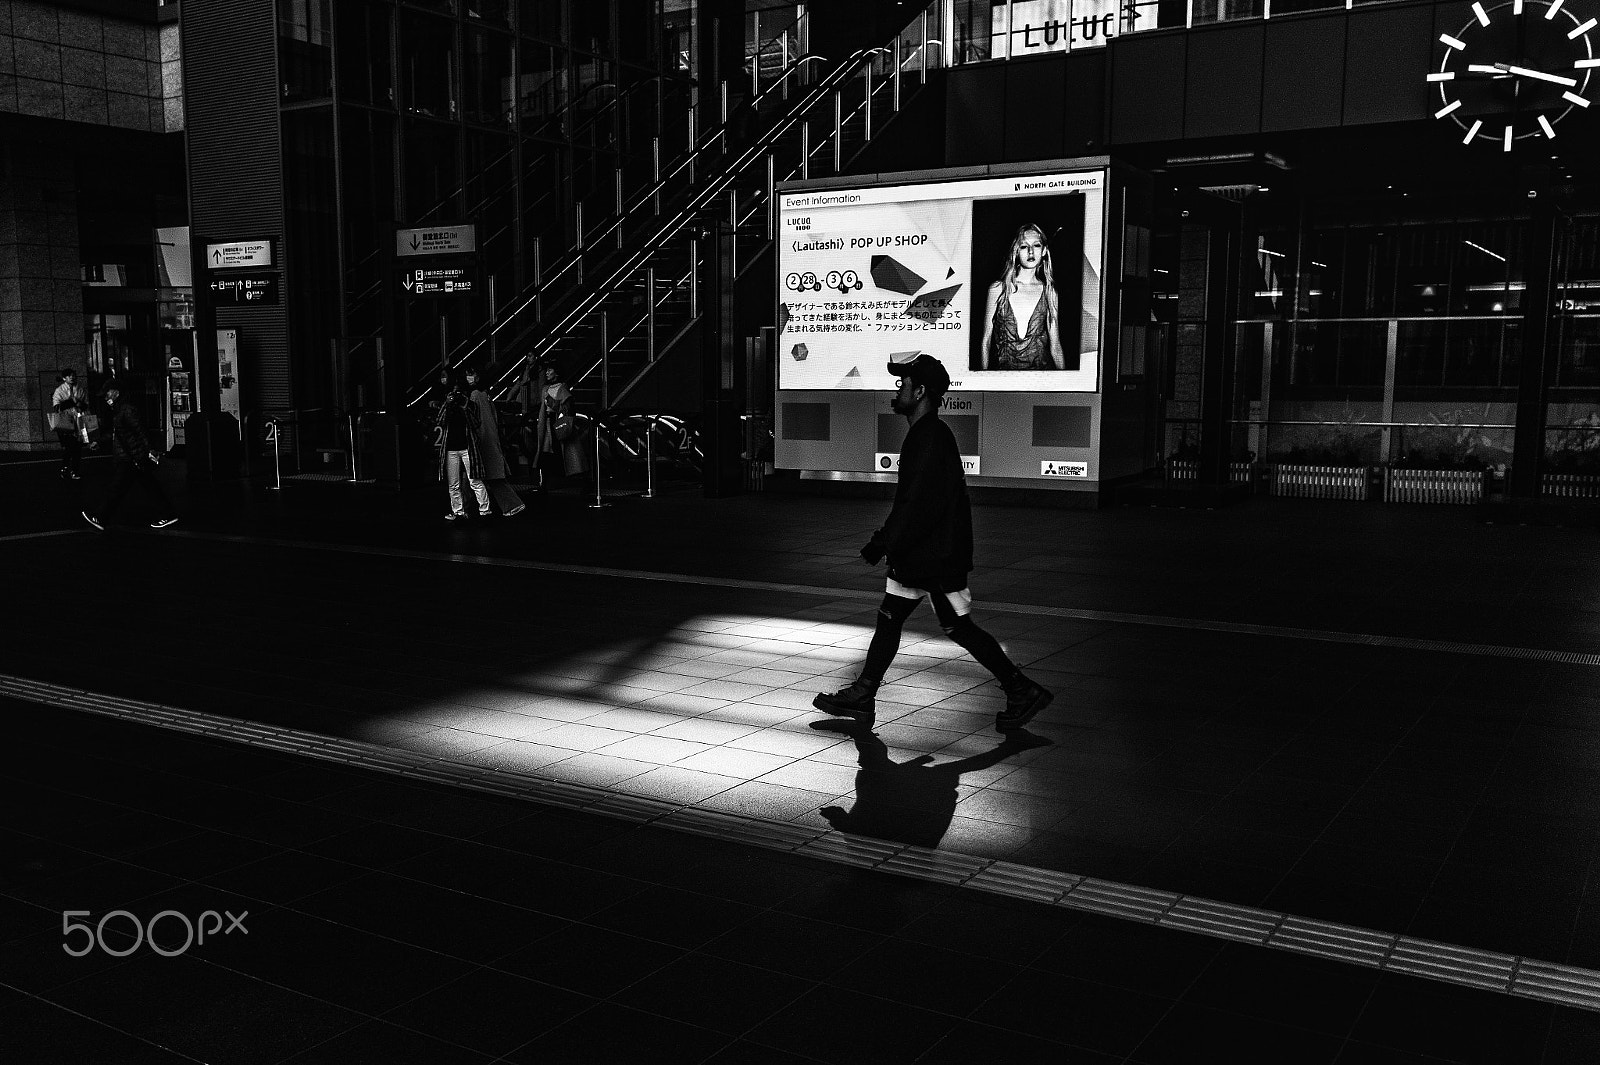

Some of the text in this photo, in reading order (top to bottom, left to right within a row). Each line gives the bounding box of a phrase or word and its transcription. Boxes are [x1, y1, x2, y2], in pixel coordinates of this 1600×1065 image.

[1048, 180, 1064, 188] GATE
[1067, 178, 1097, 187] BUILDING
[786, 194, 861, 207] Event Information
[850, 237, 873, 249] POP
[876, 236, 892, 248] UP
[895, 234, 928, 247] SHOP
[942, 396, 972, 410] Vision
[678, 427, 692, 450] 2F
[961, 461, 975, 469] ITY
